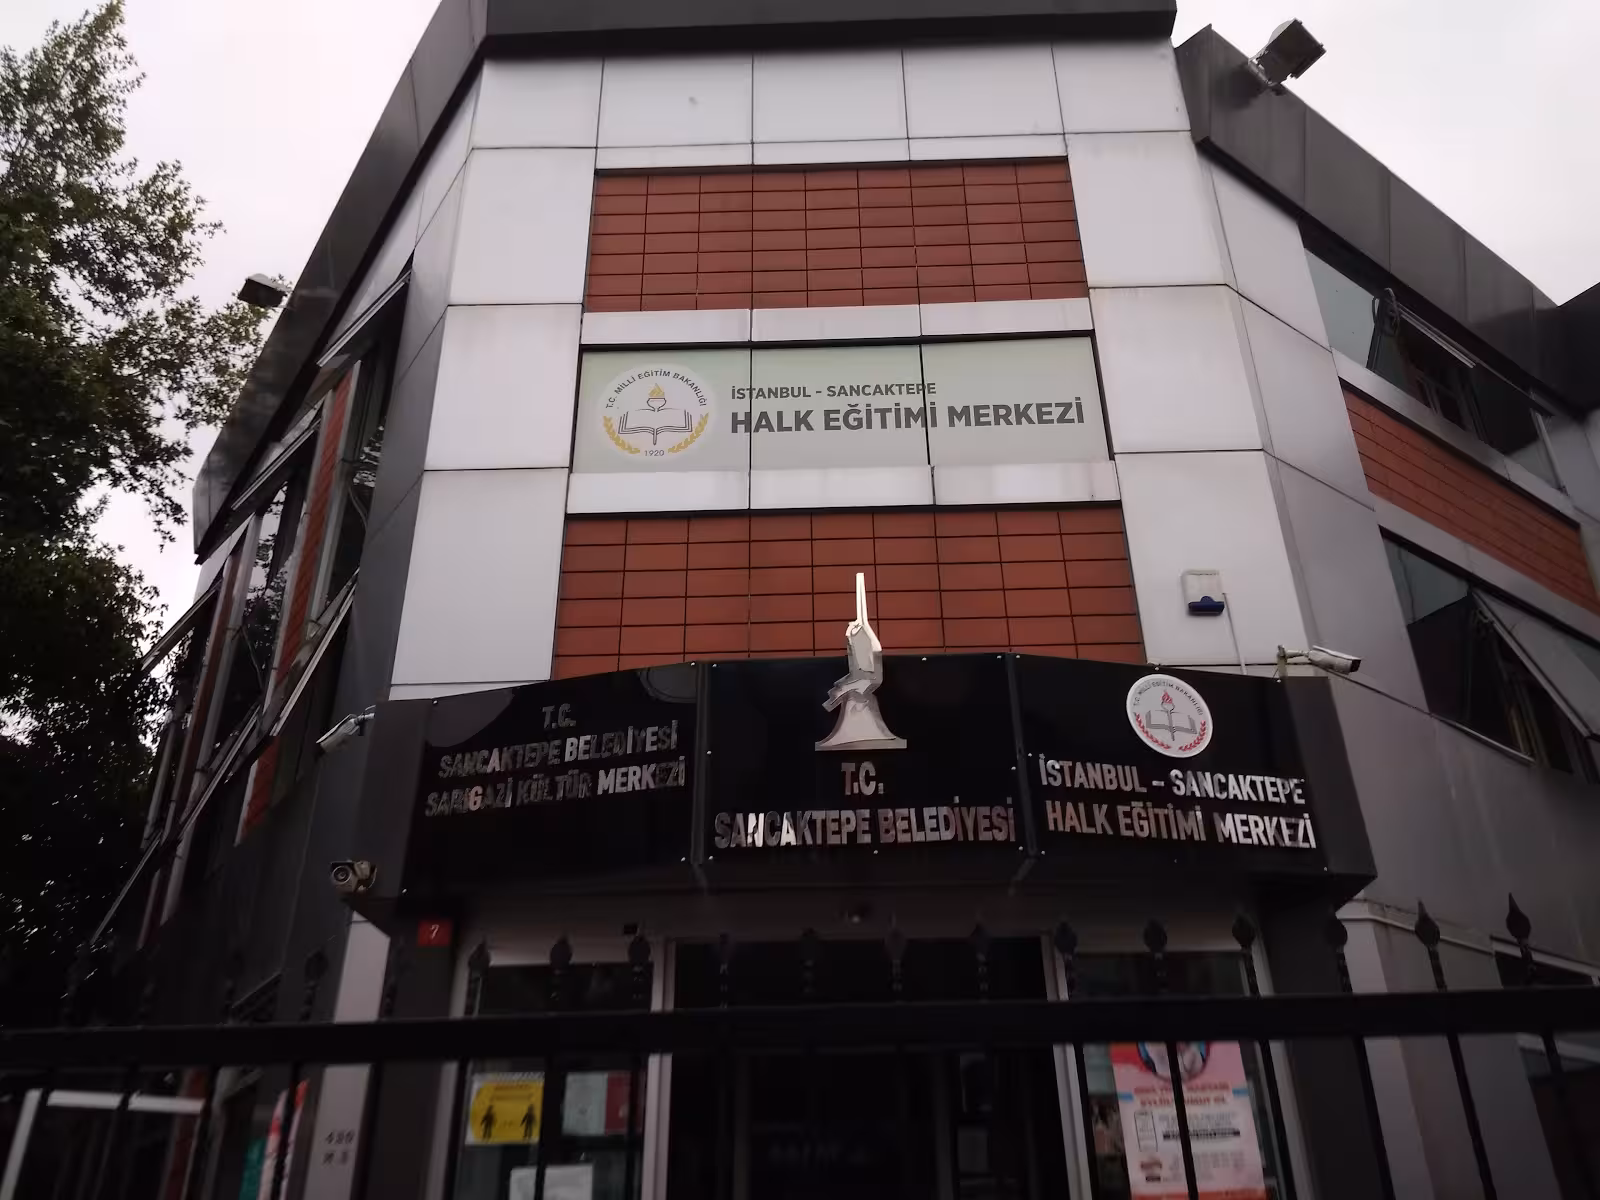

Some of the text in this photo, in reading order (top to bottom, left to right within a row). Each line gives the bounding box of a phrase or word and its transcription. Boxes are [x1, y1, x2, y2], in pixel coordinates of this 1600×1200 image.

[615, 376, 636, 396] MİLLİ
[637, 368, 671, 381] EĞİTİM
[672, 372, 708, 407] BAKANLIĞI
[731, 386, 812, 400] İSTANBUL
[826, 383, 937, 397] SANCAKTEPE
[731, 396, 1085, 434] HALK EĞİTİMİ MERKEZİ
[439, 719, 679, 778] SANCAKTEPE BELEDİYESİ
[516, 769, 593, 805] KÜLTÜR
[597, 756, 686, 796] MERKEZİ
[841, 761, 884, 796] T.C.
[1039, 753, 1147, 793] İSTANBUL
[1169, 769, 1305, 804] SANCAKTEPE
[714, 796, 1016, 848] SANCAKTEPE BELEDİYESİ
[1045, 800, 1317, 849] HALK EĞİTİMİ MERKEZİ
[430, 924, 439, 939] 7
